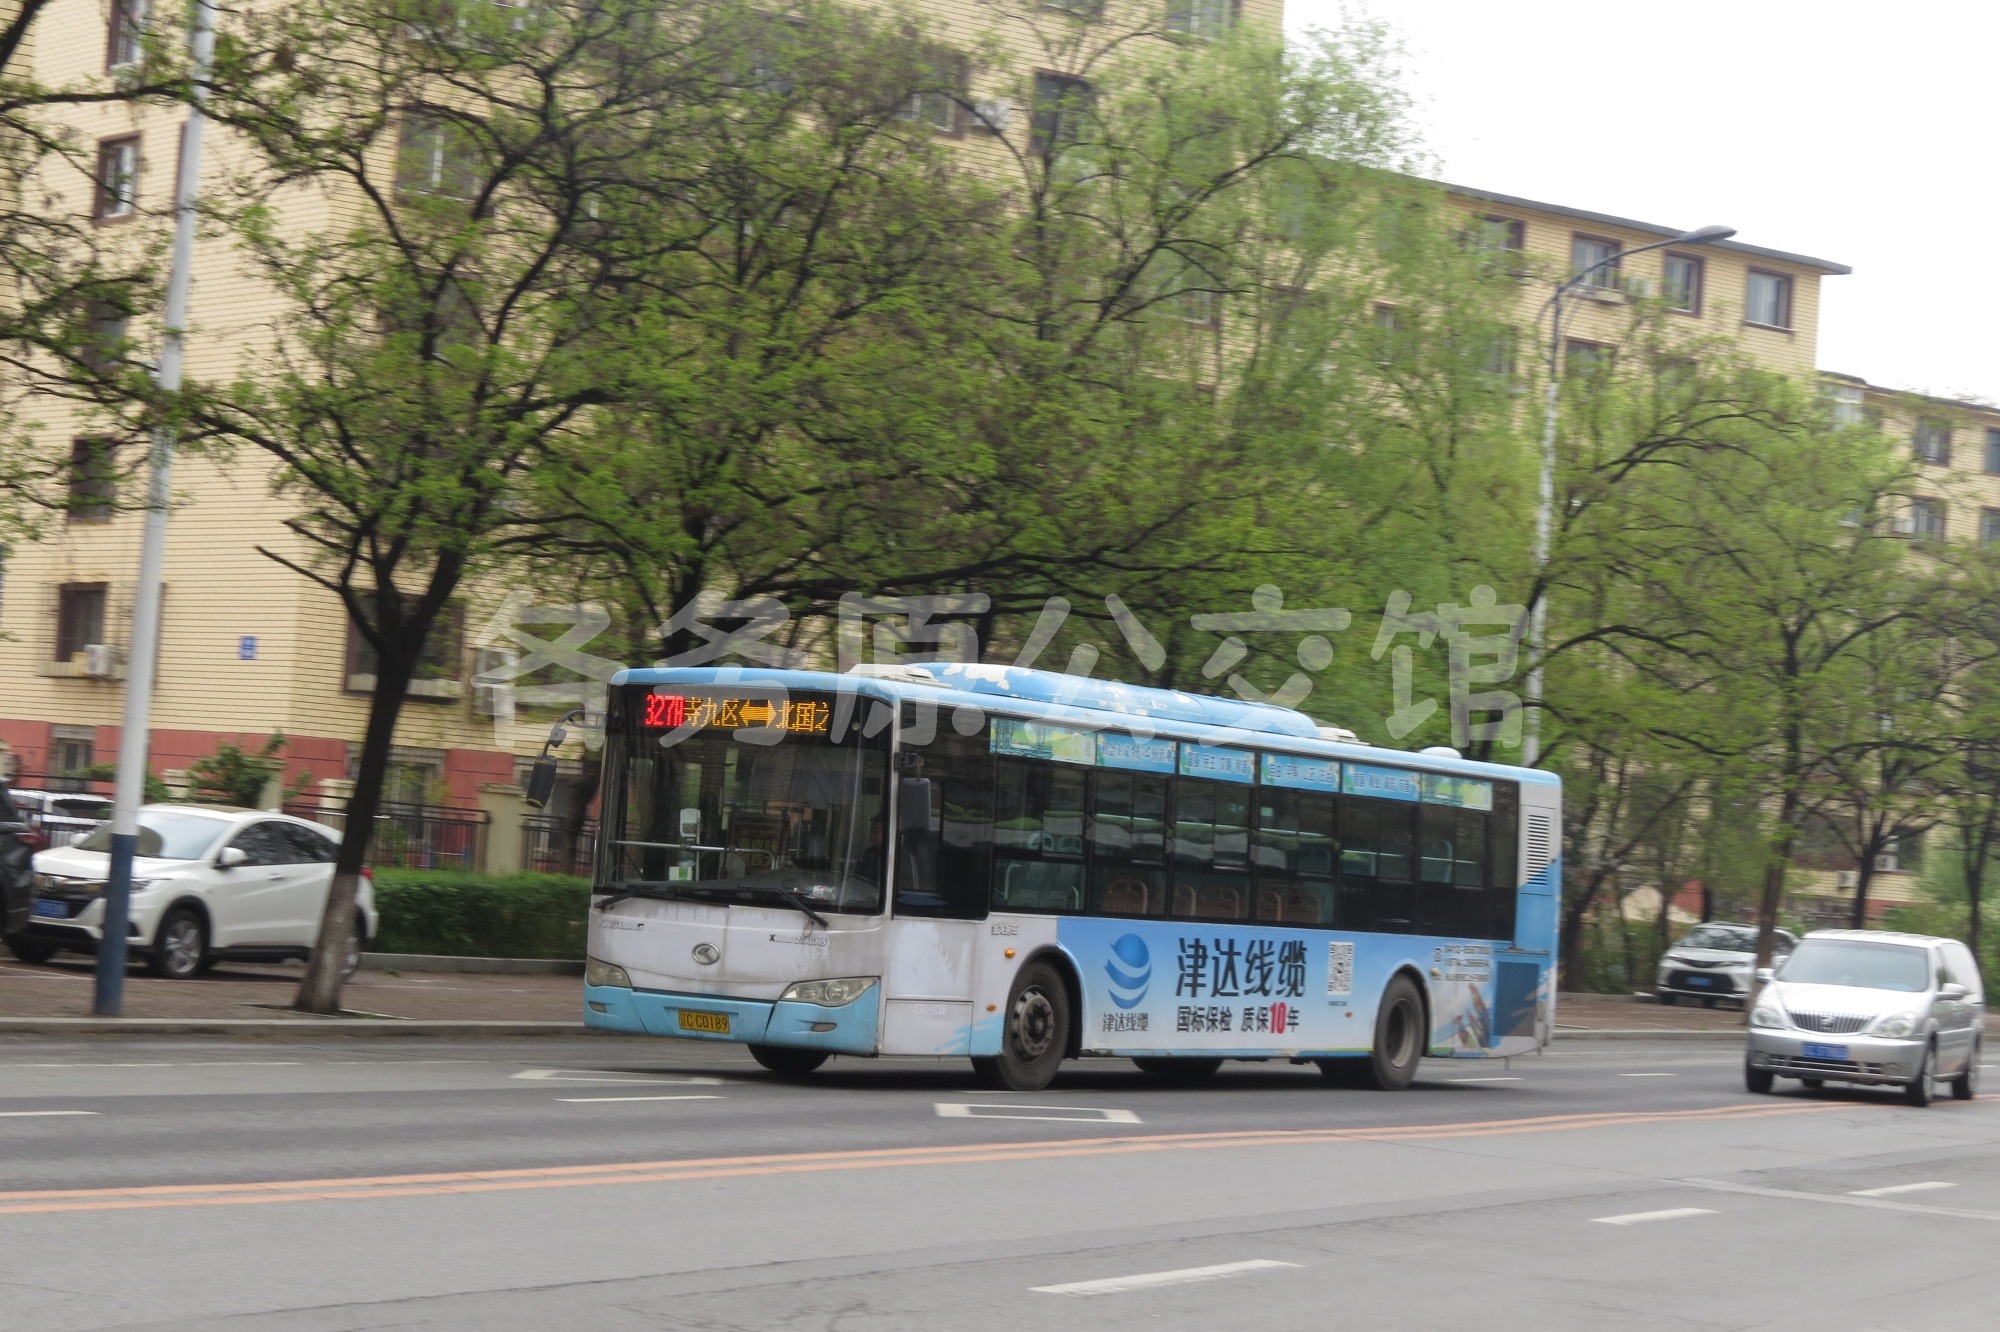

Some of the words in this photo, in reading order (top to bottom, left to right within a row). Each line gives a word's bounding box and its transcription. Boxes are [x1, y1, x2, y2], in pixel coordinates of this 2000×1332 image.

[645, 694, 684, 727] 327A
[684, 696, 739, 728] 寺九区
[1175, 937, 1308, 998] 津达线缆
[1102, 1012, 1149, 1032] 津达线缆
[1176, 1005, 1234, 1033] 国标保检
[1240, 1001, 1300, 1035] 质保10年
